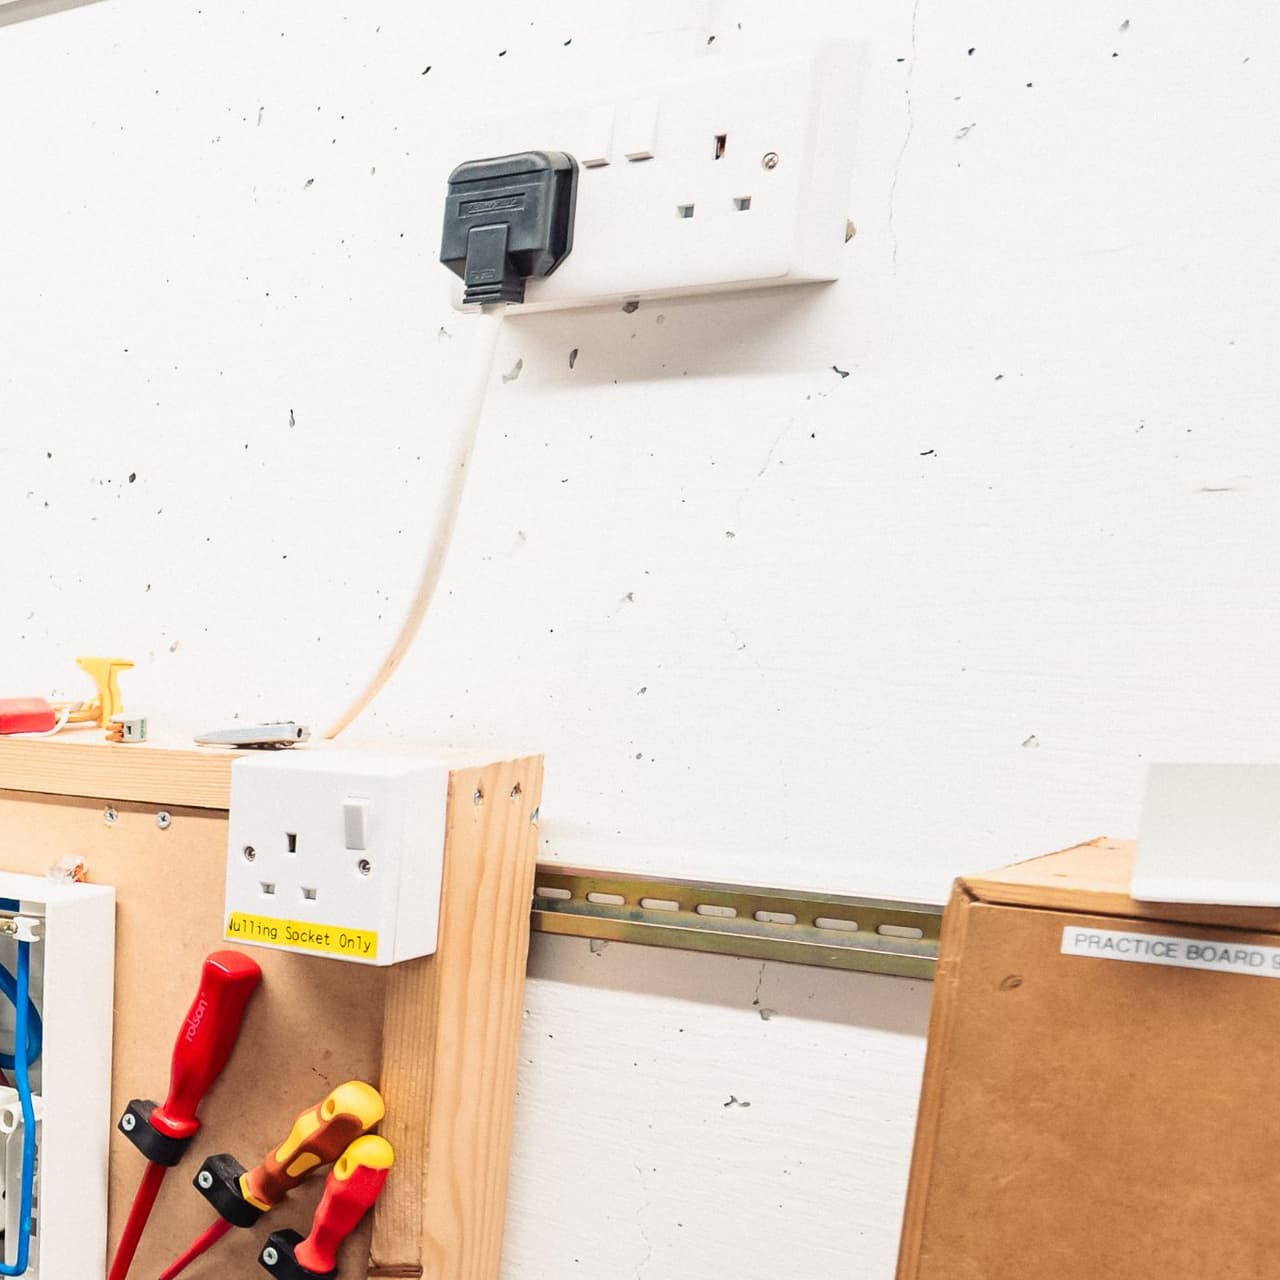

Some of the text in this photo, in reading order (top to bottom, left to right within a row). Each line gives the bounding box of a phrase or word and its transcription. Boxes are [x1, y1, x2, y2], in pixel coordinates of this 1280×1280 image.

[285, 926, 331, 946] Socket
[339, 933, 372, 953] Only
[1074, 932, 1179, 959] PRACTICE
[1185, 943, 1265, 968] BOARD
[185, 999, 208, 1042] rolson
